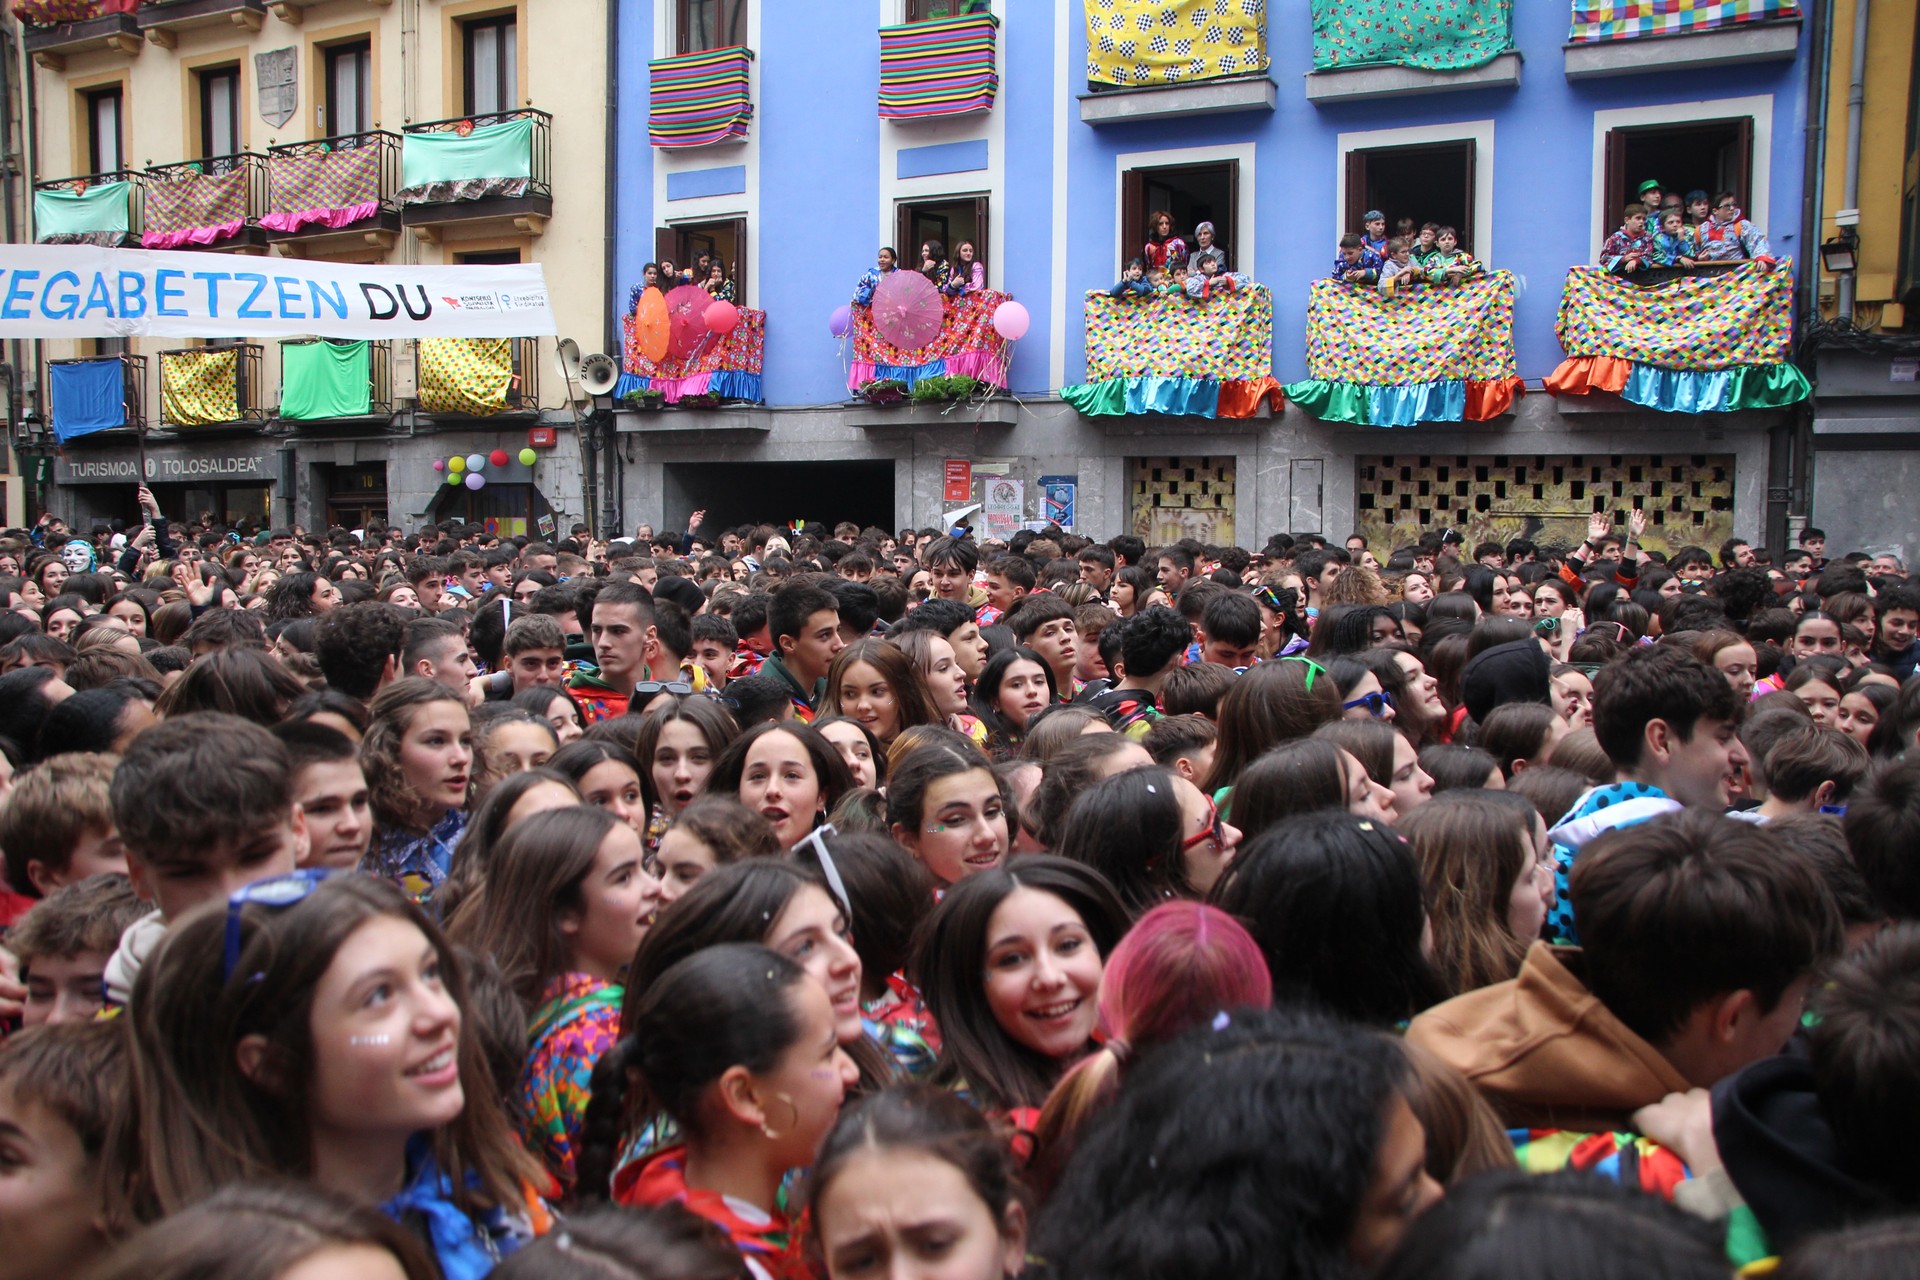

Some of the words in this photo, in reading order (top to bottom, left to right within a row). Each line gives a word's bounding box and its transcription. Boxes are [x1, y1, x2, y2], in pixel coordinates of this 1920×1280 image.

[0, 268, 348, 320] EGABETZEN
[359, 283, 432, 320] DU
[581, 356, 613, 380] ZUMETA
[70, 461, 137, 477] TURISMOA
[362, 475, 373, 488] 10
